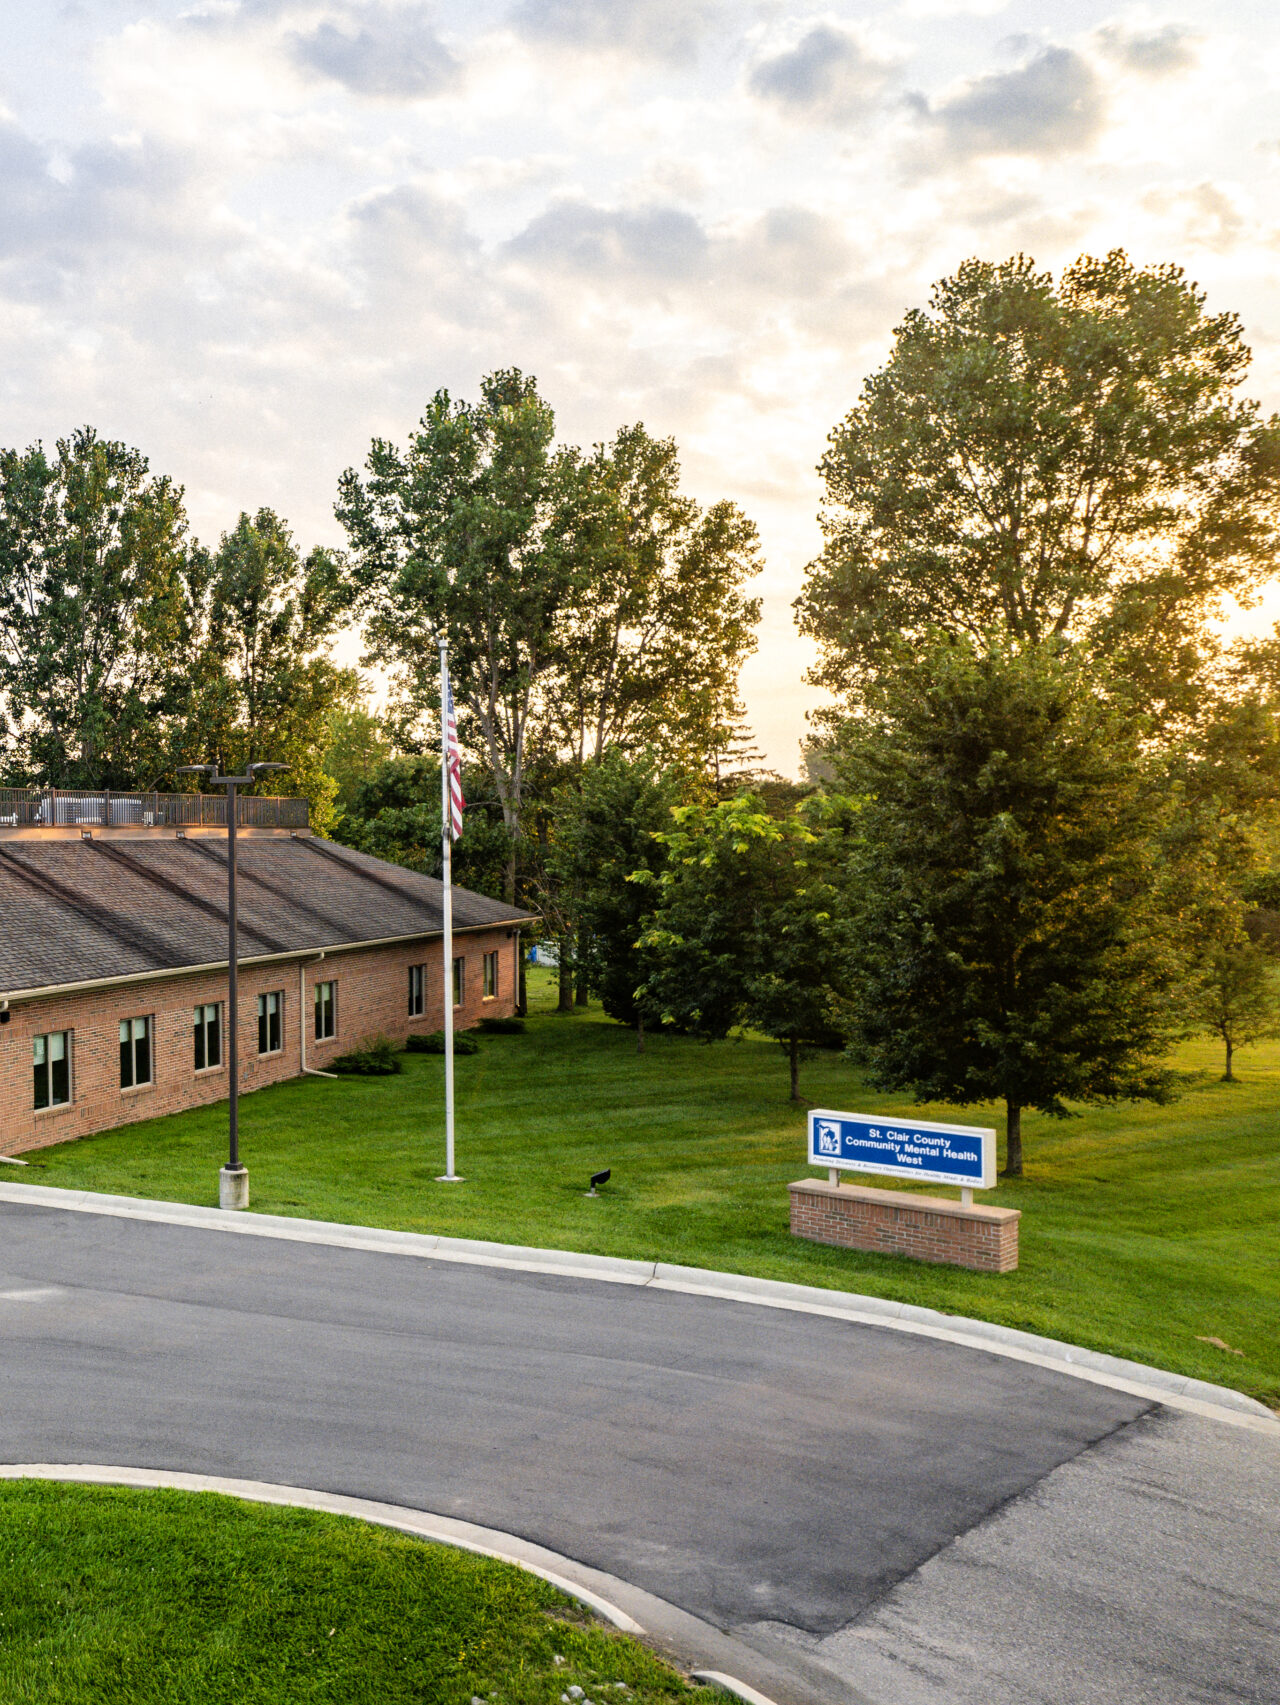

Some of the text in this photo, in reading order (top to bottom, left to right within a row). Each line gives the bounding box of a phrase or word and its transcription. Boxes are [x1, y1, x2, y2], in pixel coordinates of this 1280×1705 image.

[869, 1129, 951, 1148] St. Clair County
[845, 1136, 978, 1162] Community Mental Health
[896, 1153, 923, 1165] West
